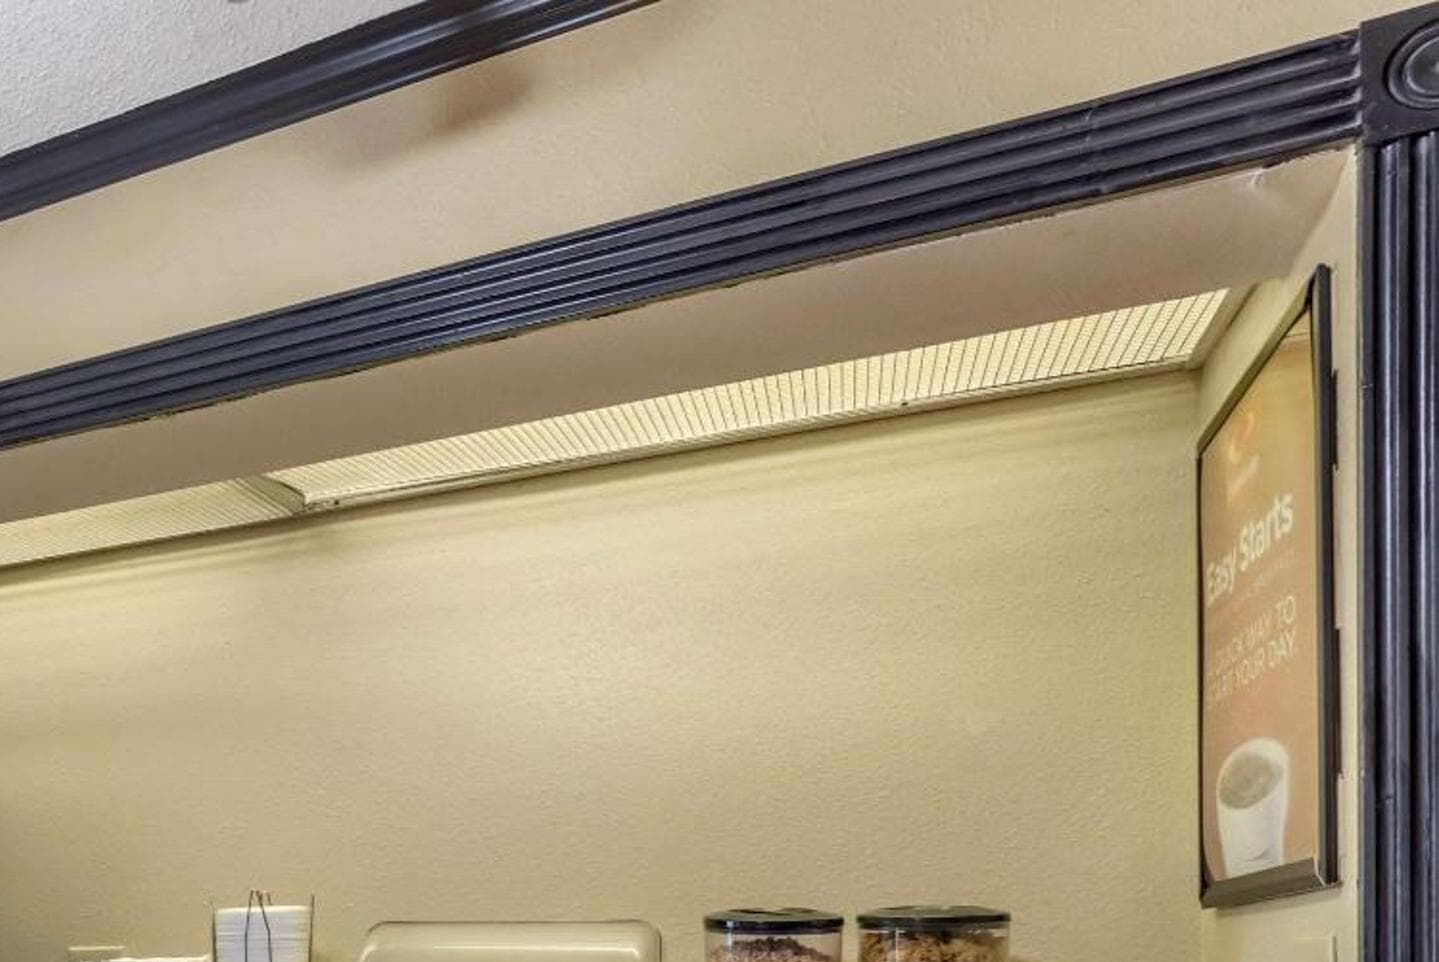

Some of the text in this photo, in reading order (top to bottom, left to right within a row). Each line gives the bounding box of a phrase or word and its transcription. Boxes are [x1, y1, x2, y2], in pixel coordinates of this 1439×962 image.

[1207, 546, 1236, 608] Easy
[1240, 493, 1293, 573] Starts
[1276, 595, 1296, 630] TO
